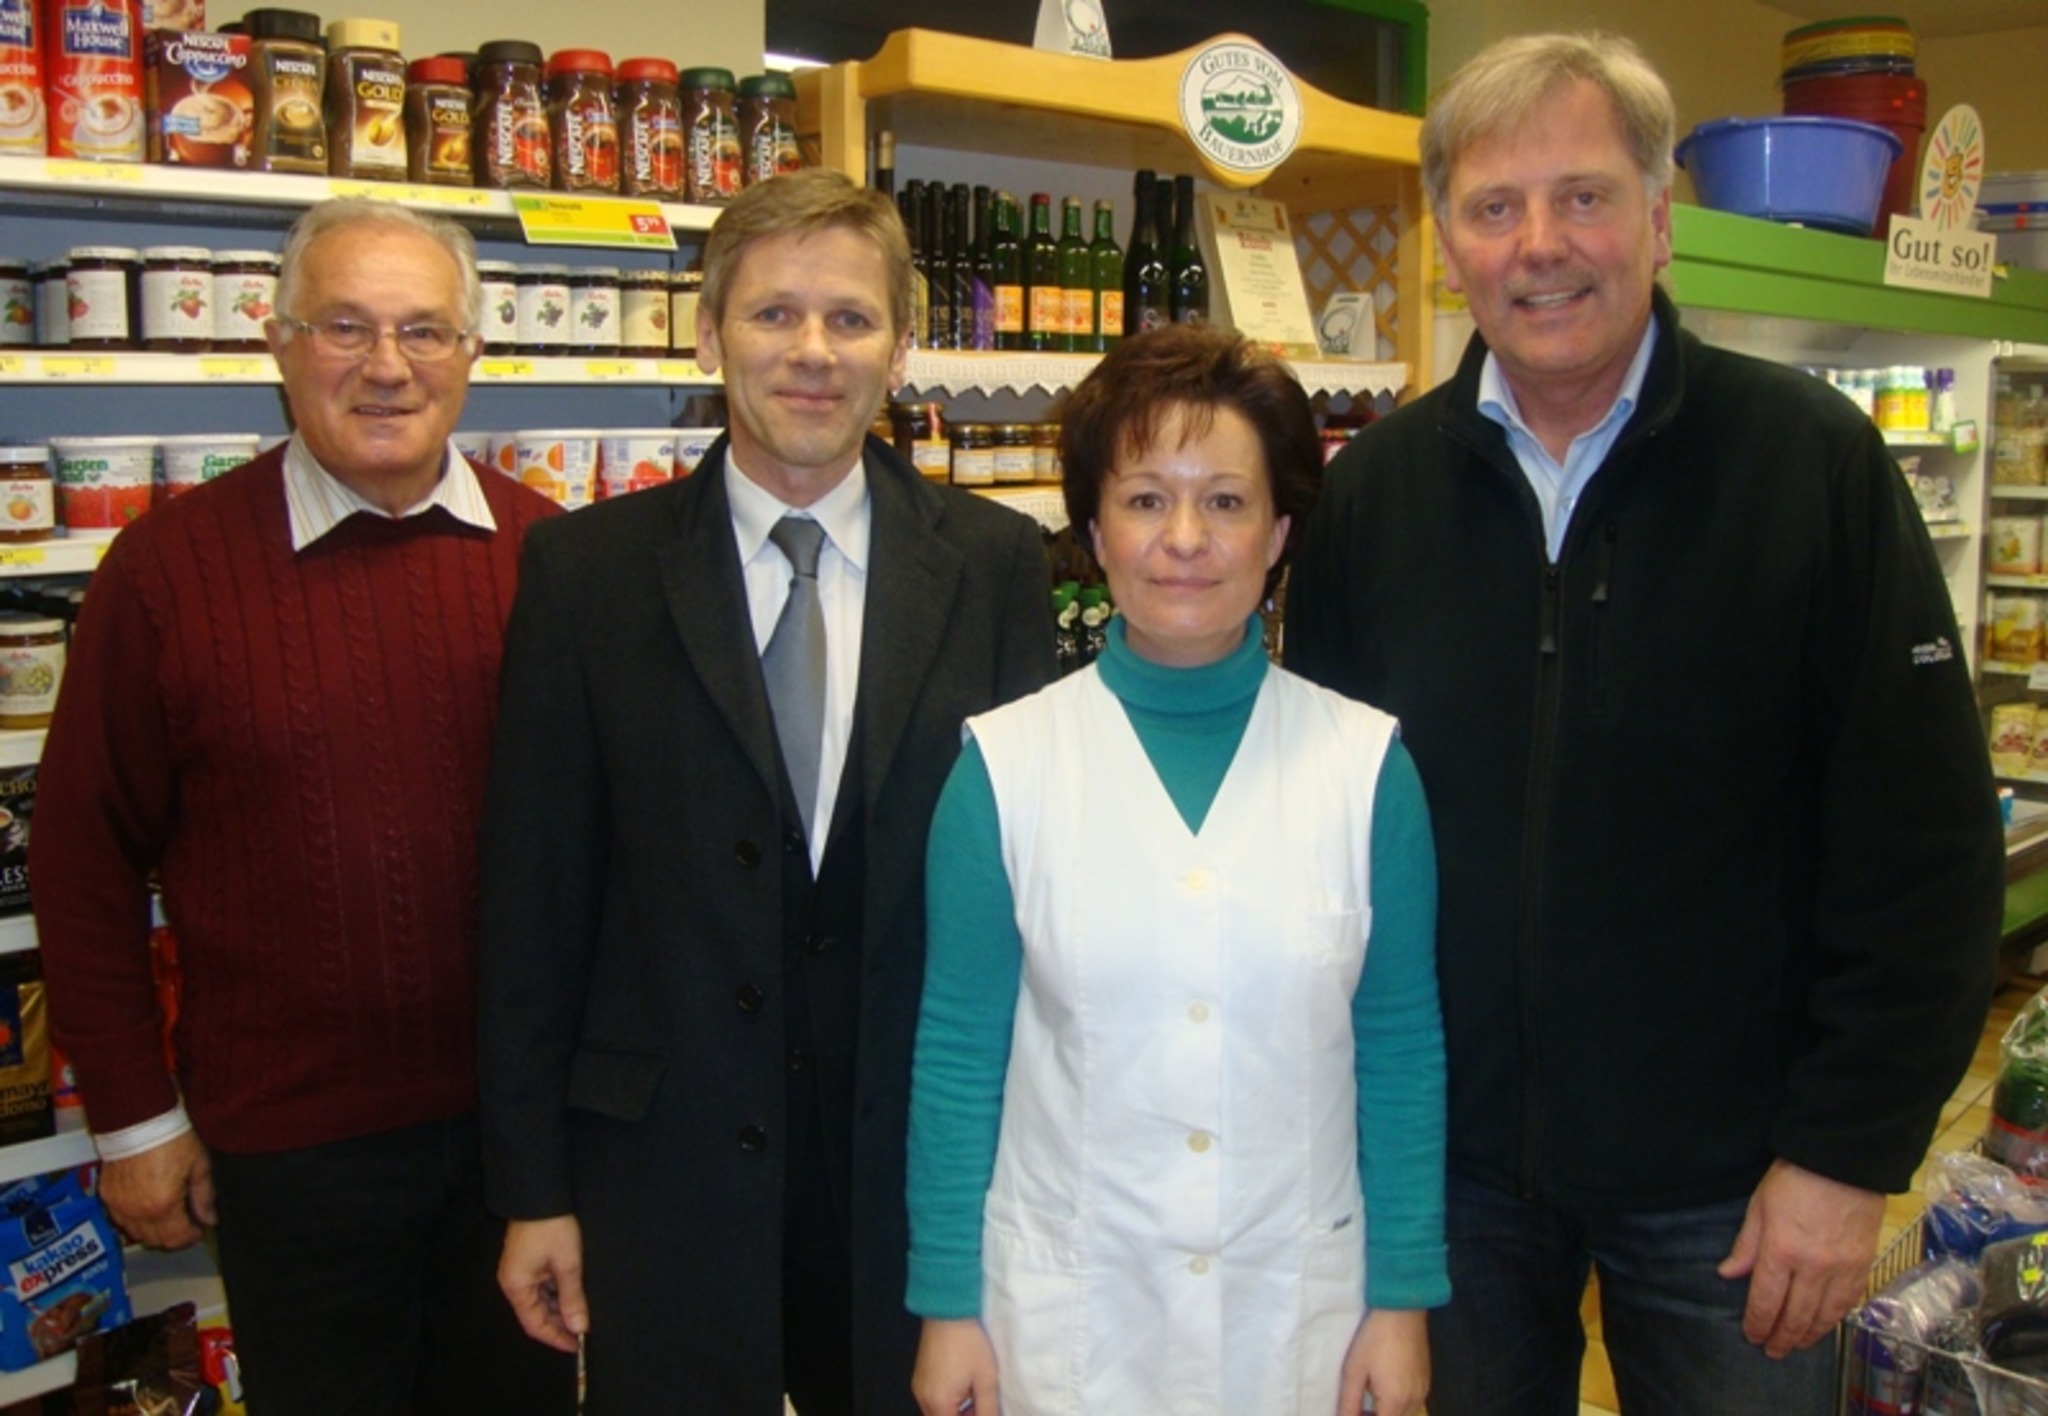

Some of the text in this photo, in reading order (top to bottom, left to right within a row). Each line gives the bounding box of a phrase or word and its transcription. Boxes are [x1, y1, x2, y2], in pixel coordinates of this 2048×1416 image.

[66, 17, 129, 37] Maxwell
[73, 33, 124, 49] House
[1201, 51, 1250, 75] GUTES
[357, 81, 405, 101] GOLD
[1893, 228, 1990, 272] Gut so!
[22, 1233, 84, 1274] kakao
[20, 1239, 99, 1294] express
